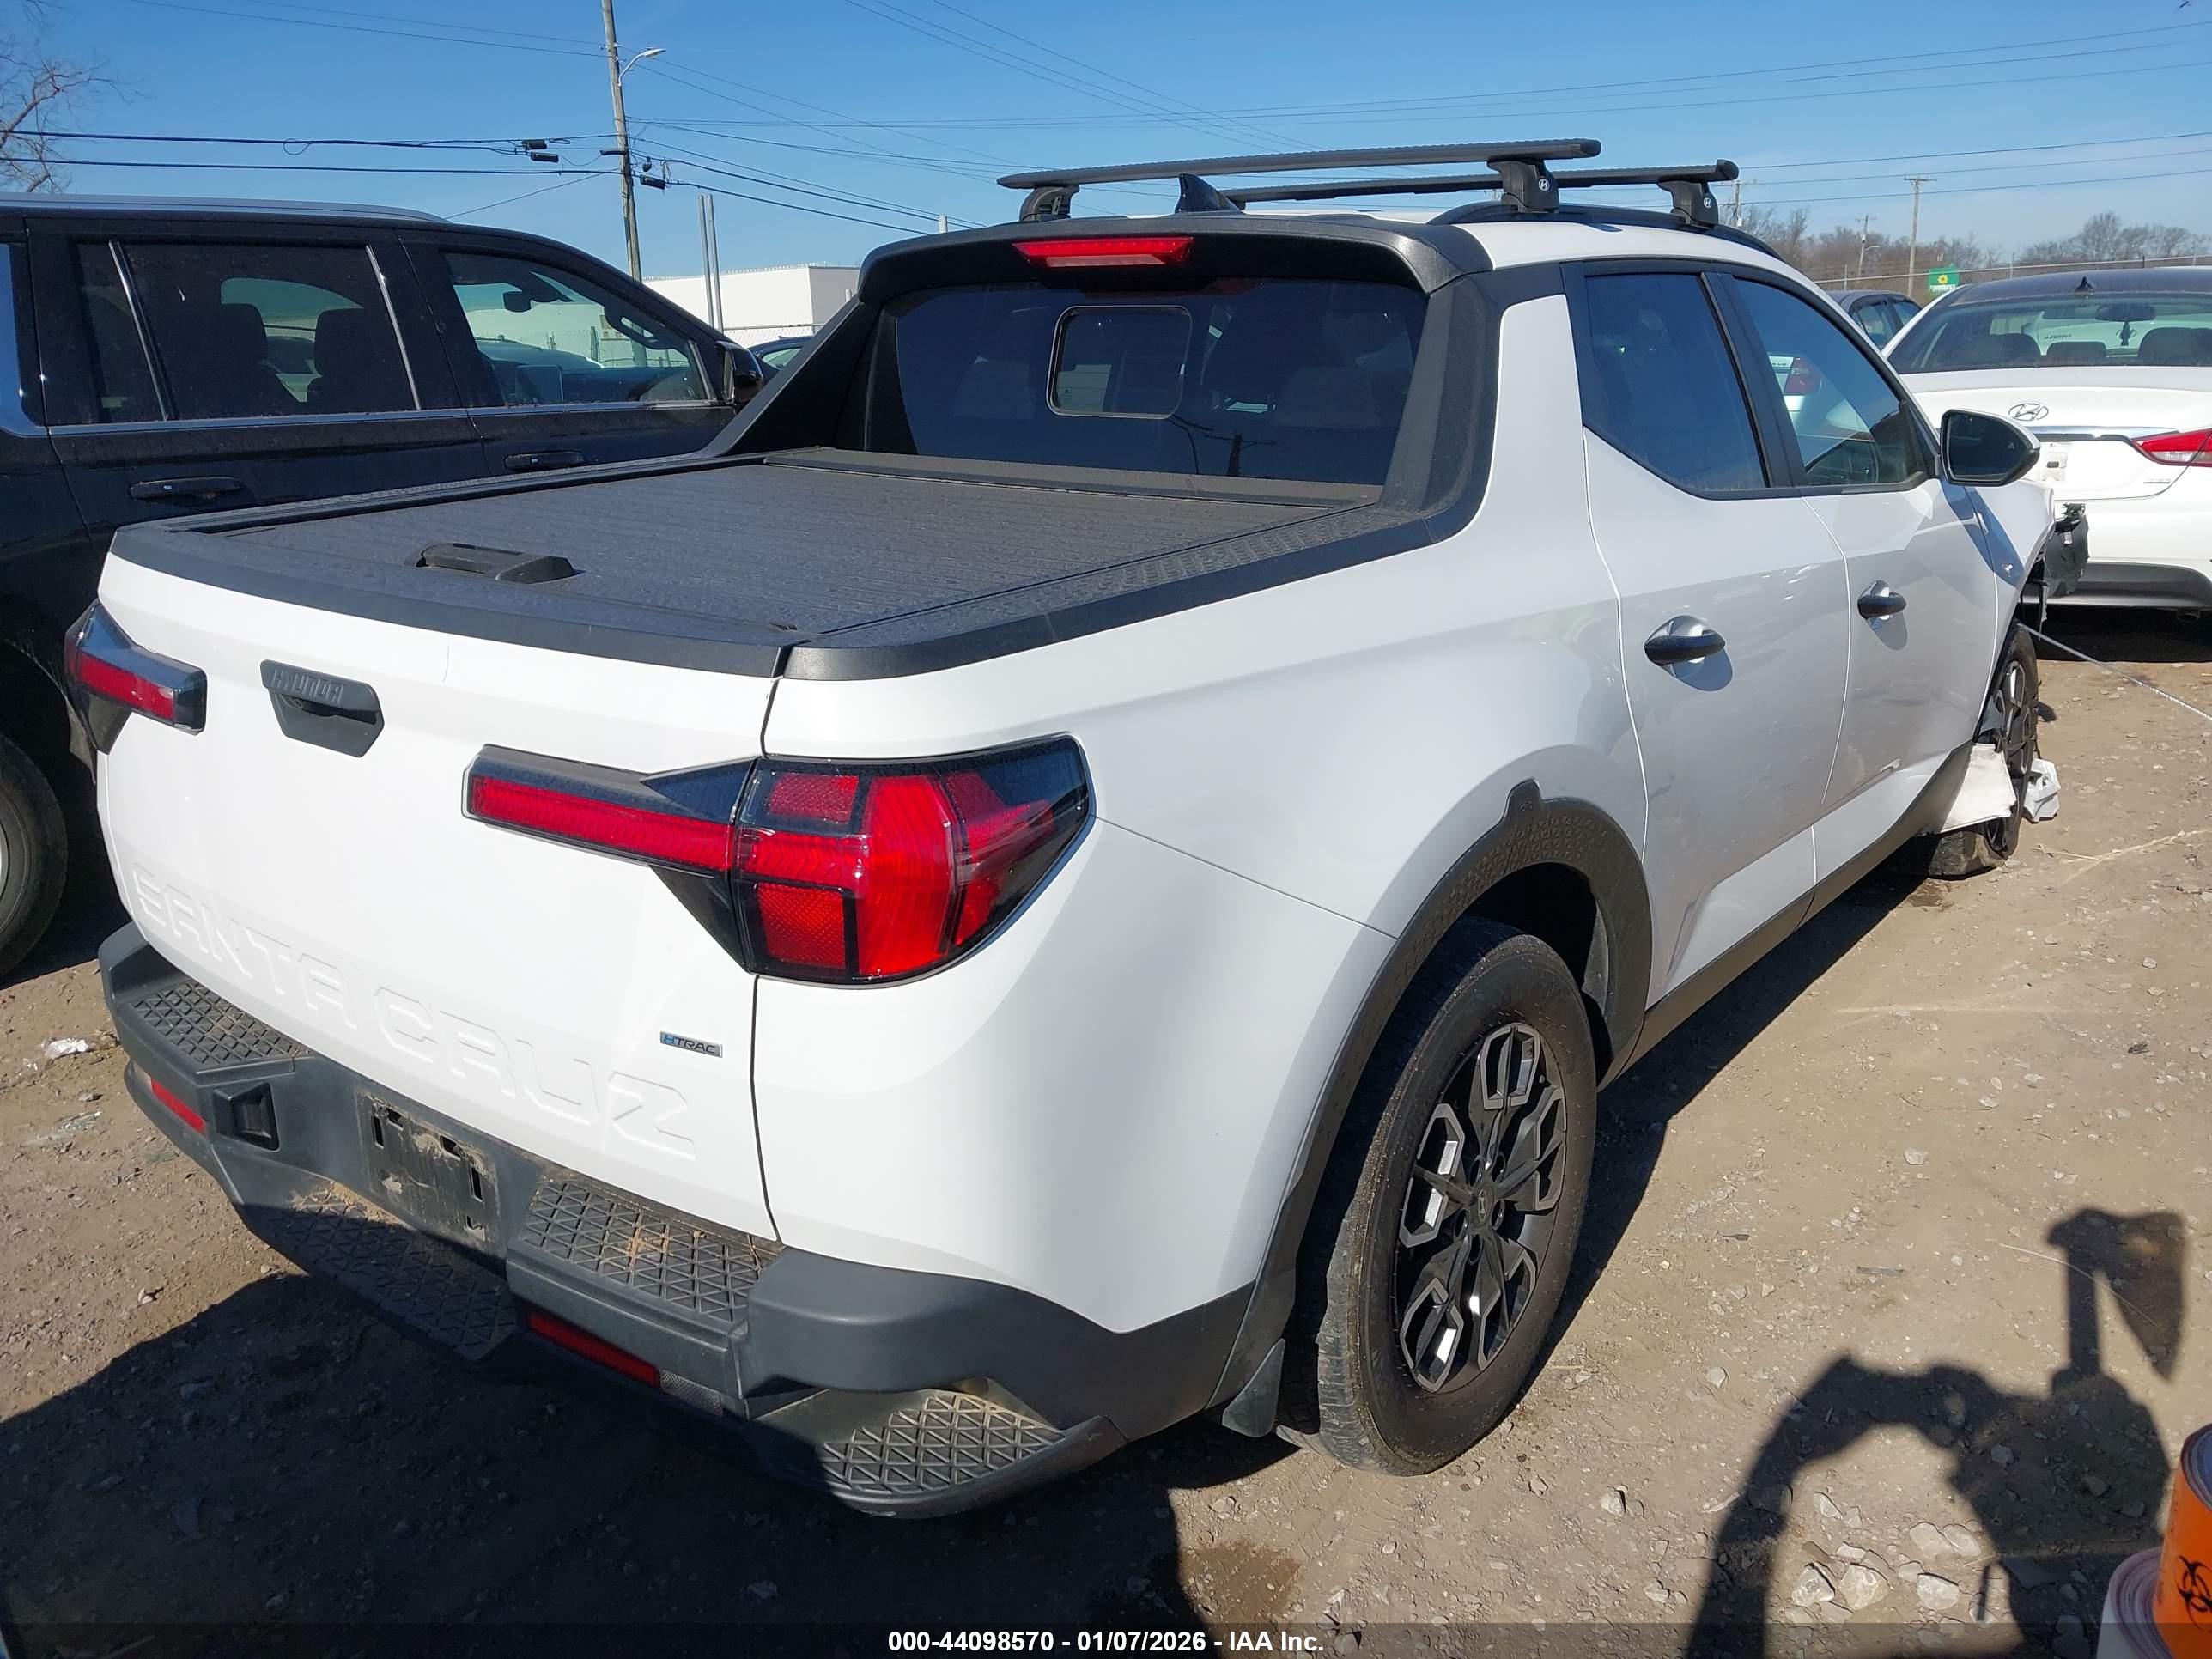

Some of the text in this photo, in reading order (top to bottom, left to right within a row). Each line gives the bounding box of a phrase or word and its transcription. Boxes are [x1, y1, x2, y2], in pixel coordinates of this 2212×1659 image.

[270, 668, 344, 705] HYUNDAI
[132, 861, 698, 1160] SANTA CRUZ
